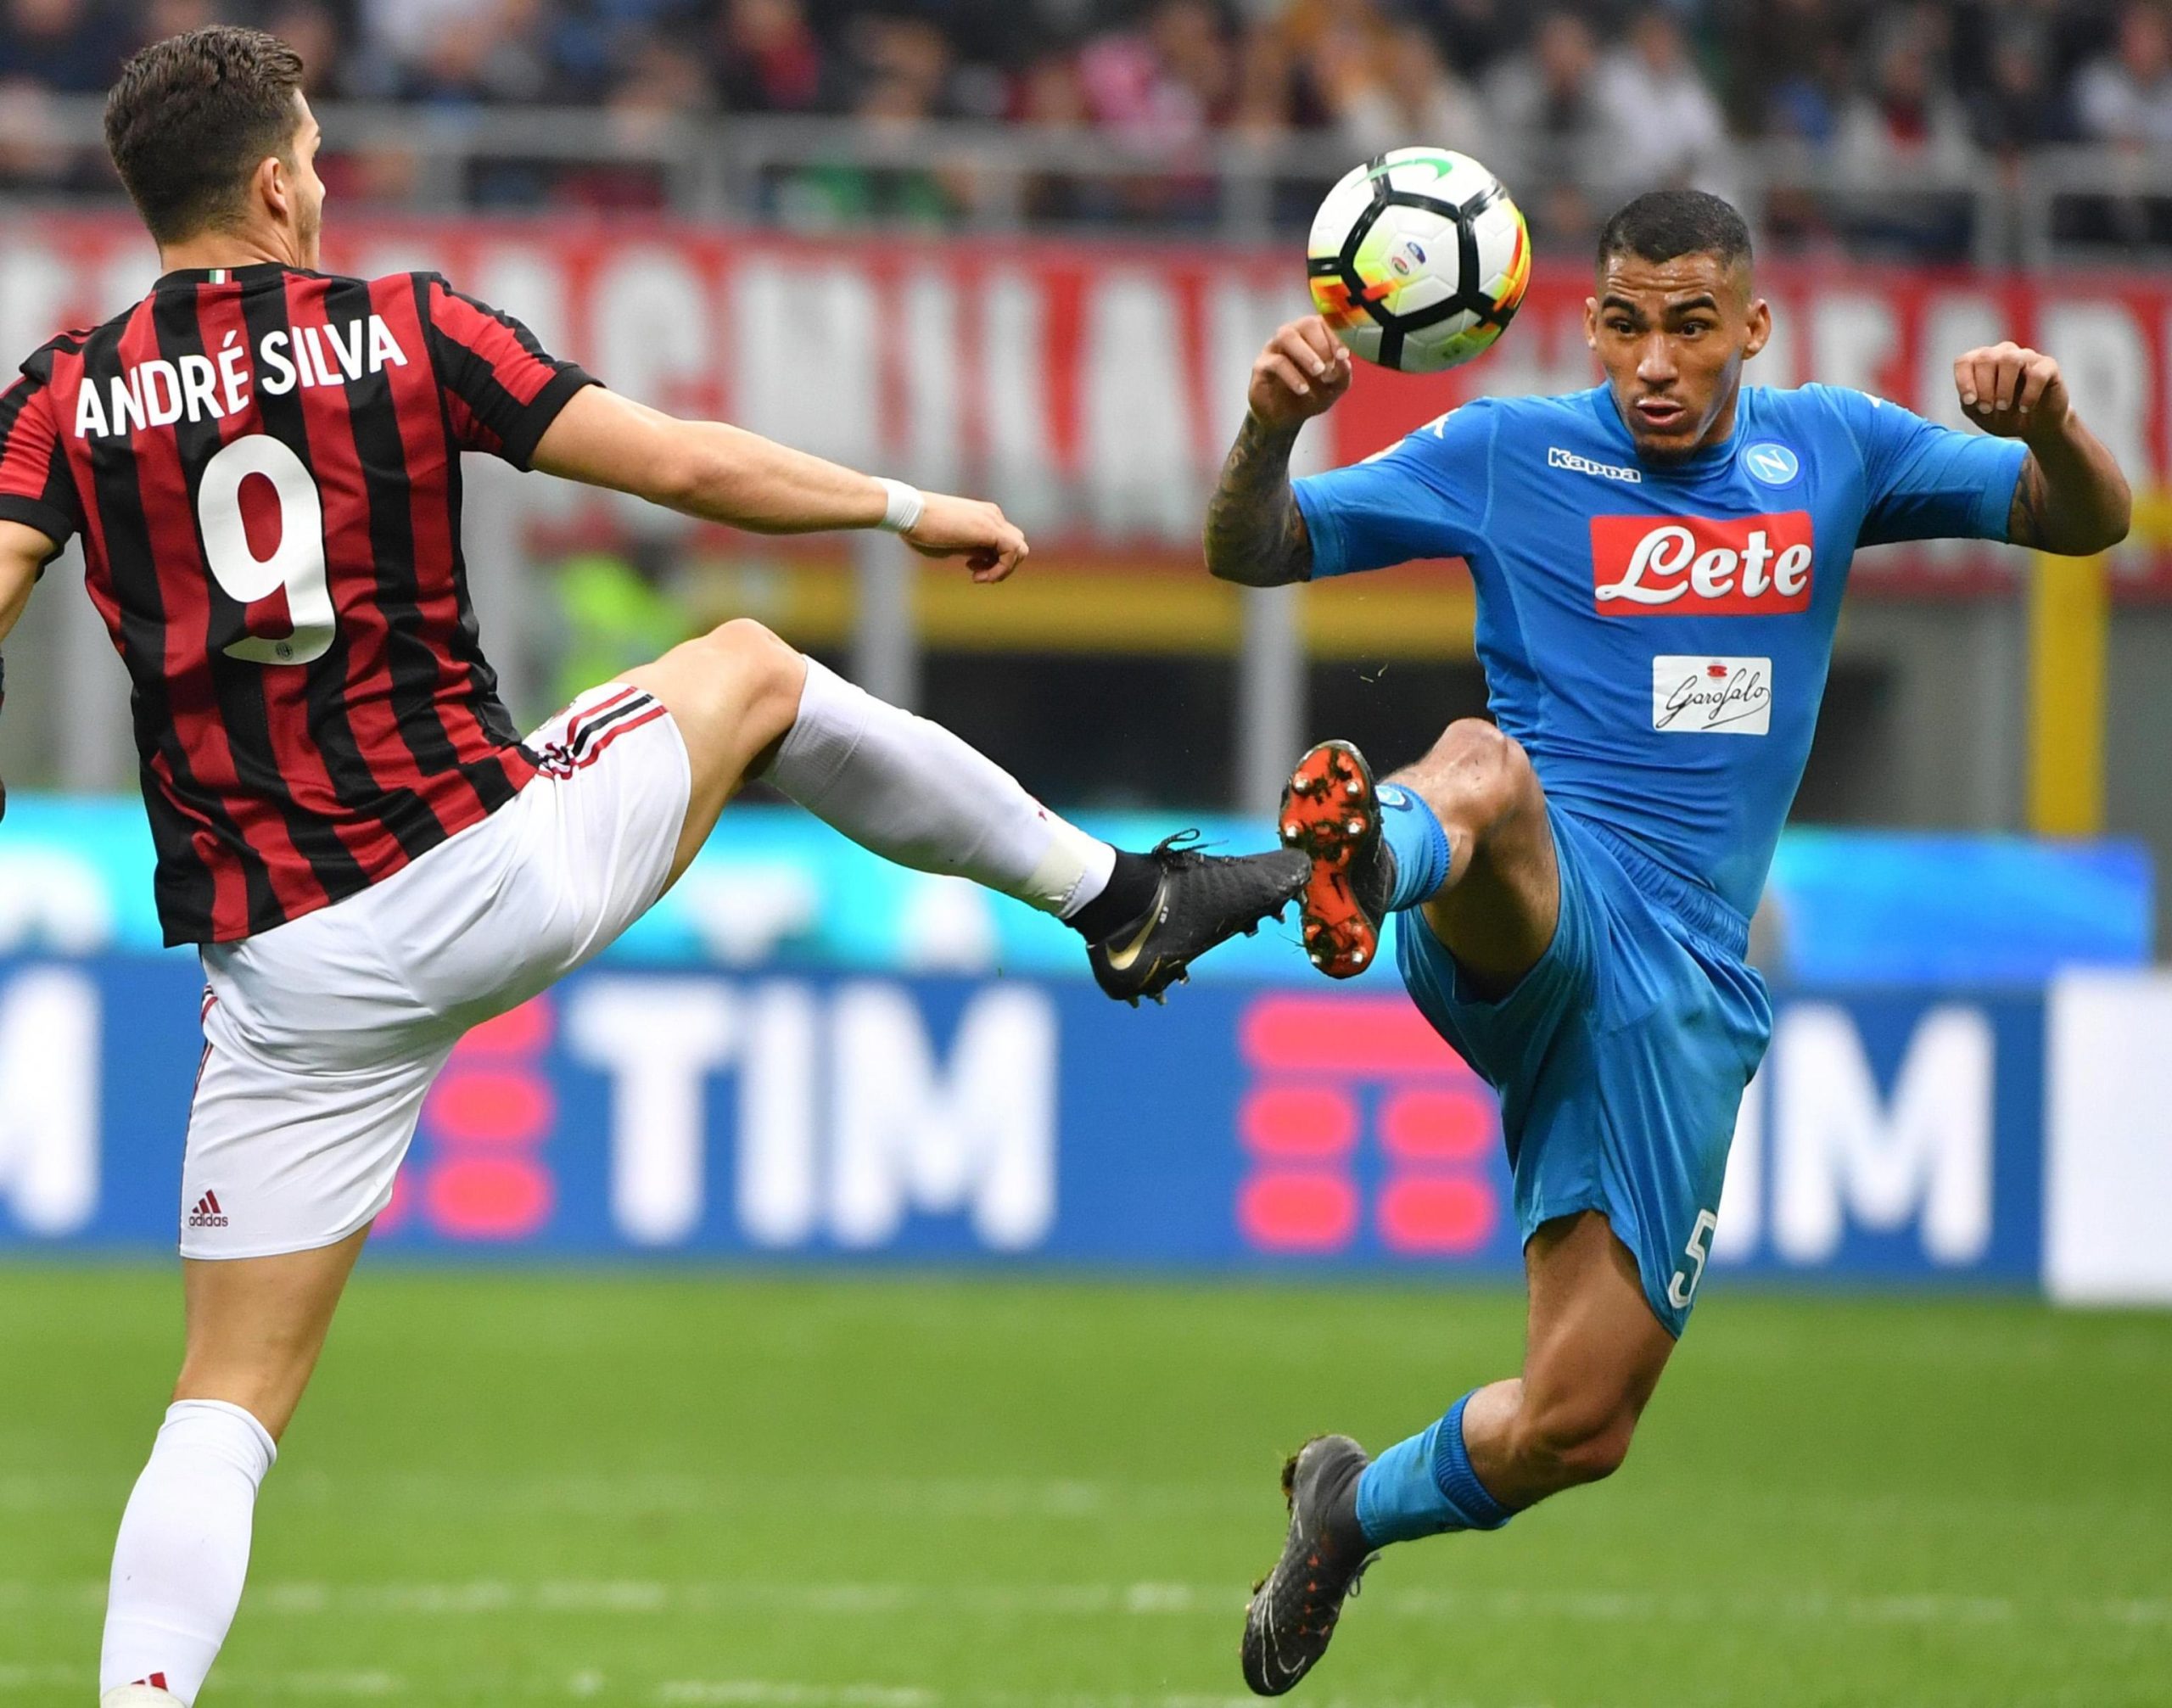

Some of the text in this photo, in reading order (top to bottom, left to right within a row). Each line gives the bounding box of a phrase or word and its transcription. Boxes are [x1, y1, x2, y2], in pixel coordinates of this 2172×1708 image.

[73, 314, 408, 439] ANDRÉ SILVA
[1548, 446, 1643, 484] Kappa
[197, 434, 337, 666] 9
[1594, 524, 1813, 605] Lete
[1655, 667, 1772, 730] Garofalo
[567, 980, 1061, 1247] TIM
[188, 1213, 229, 1228] adidas
[1667, 1207, 1718, 1309] 5
